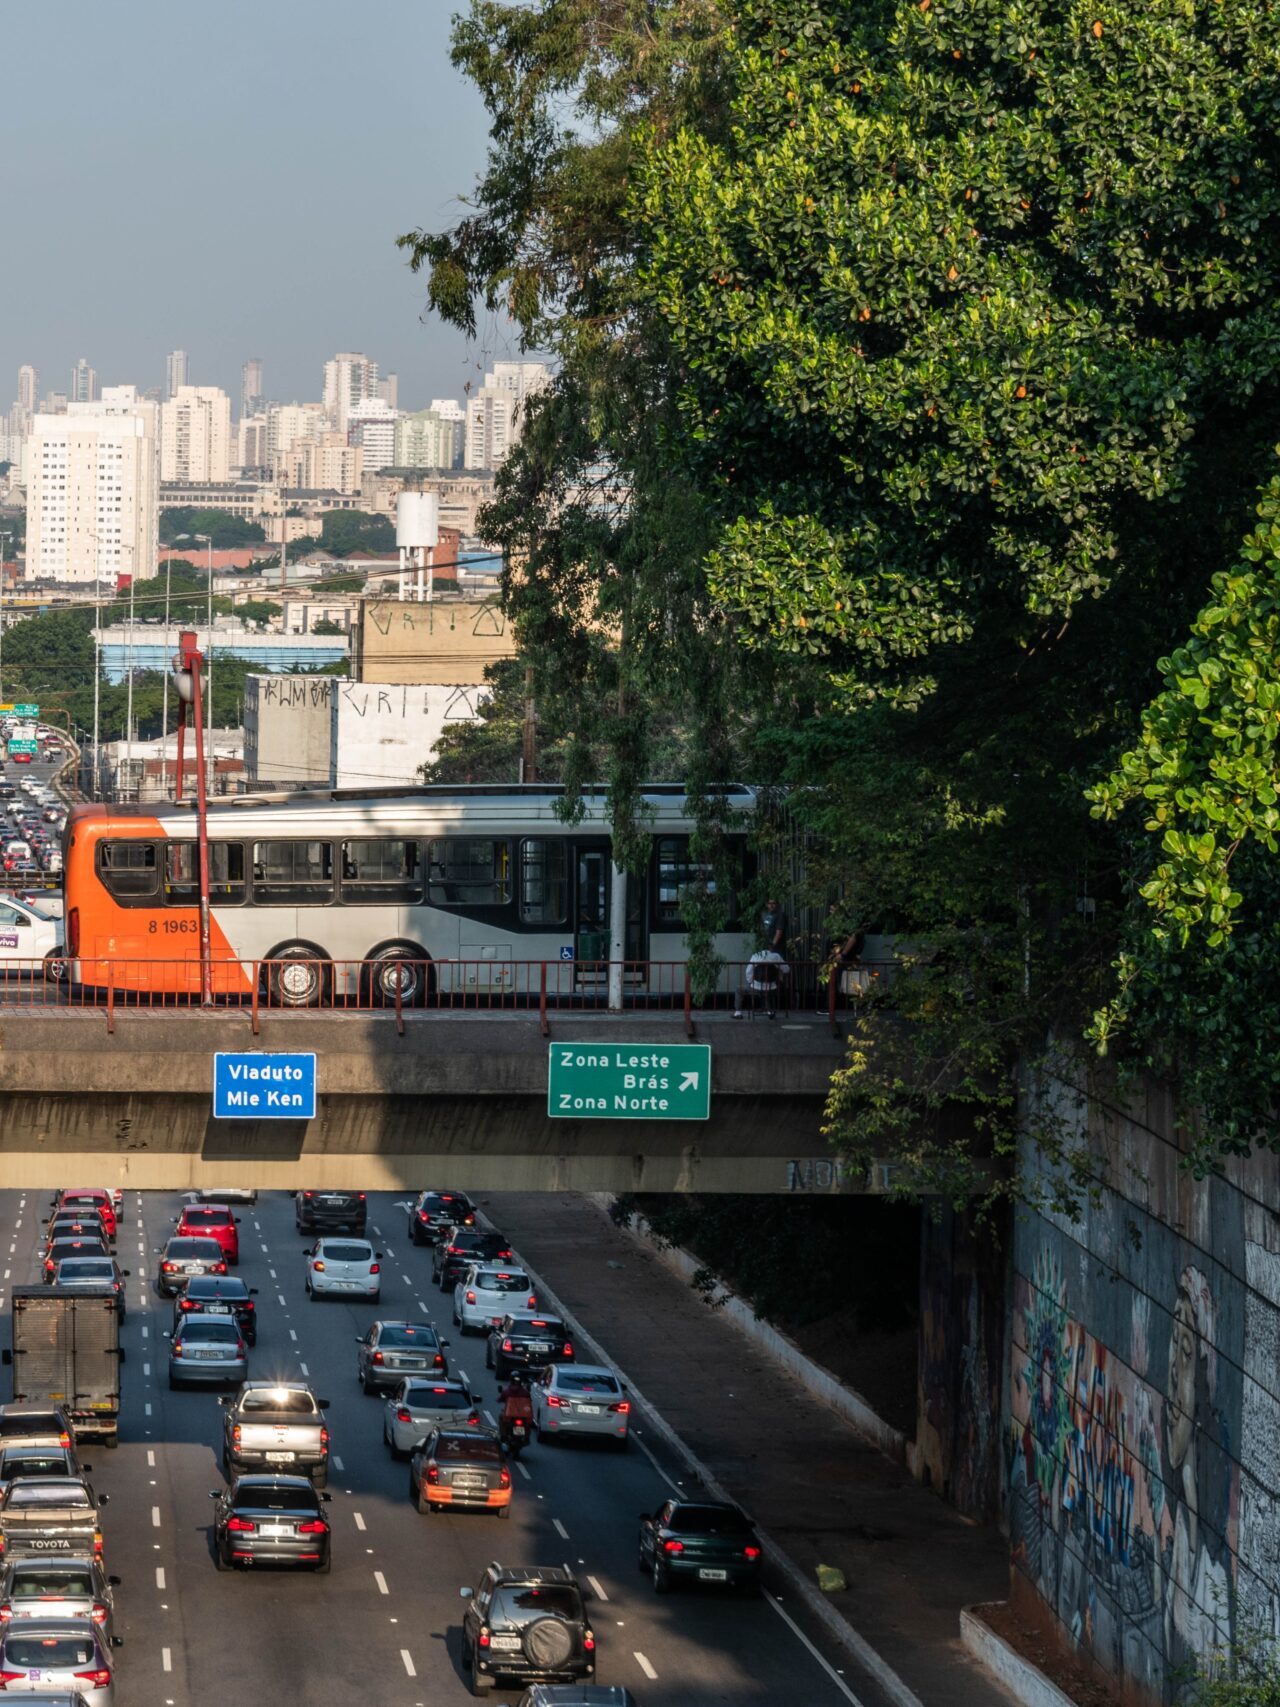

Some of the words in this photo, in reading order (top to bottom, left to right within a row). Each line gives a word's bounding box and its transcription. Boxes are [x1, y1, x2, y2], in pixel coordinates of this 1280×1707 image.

[148, 920, 157, 933] 8
[162, 920, 198, 933] 1963
[560, 1052, 609, 1067] Zona
[616, 1053, 670, 1068] Leste
[228, 1064, 303, 1080] Viaduto
[623, 1074, 669, 1089] Brás
[227, 1091, 260, 1106] Mie
[267, 1091, 303, 1106] Ken
[559, 1094, 607, 1109] Zona
[614, 1095, 669, 1110] Norte
[30, 1540, 70, 1548] TOYOTA
